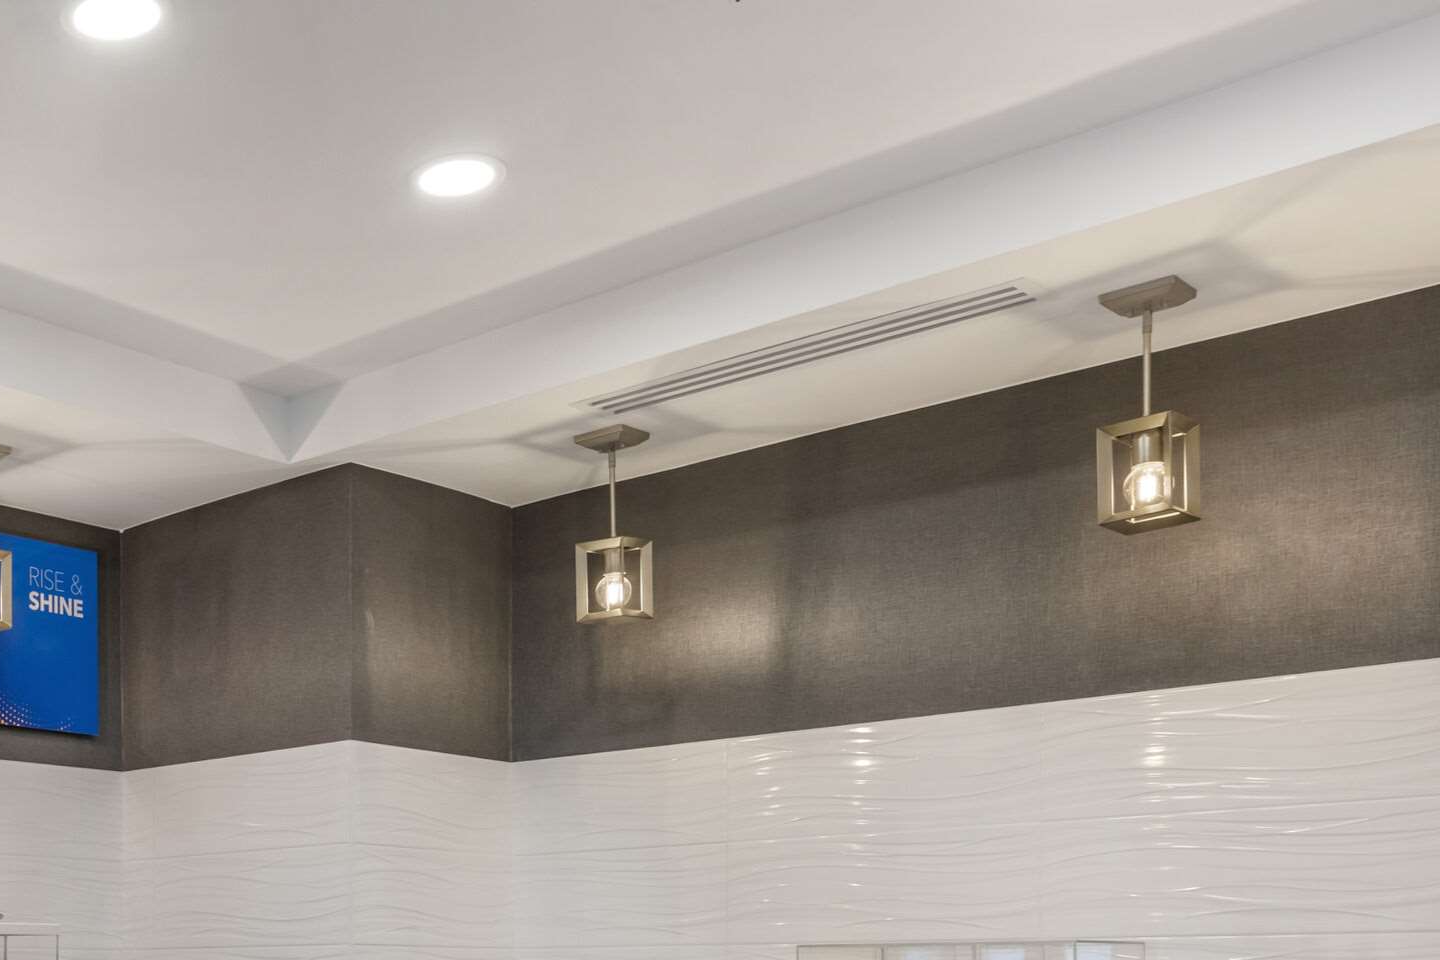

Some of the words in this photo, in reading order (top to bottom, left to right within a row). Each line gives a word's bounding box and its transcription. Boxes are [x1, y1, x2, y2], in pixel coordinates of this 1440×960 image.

[29, 566, 65, 593] RISE
[70, 574, 82, 596] &
[28, 591, 84, 619] SHINE
